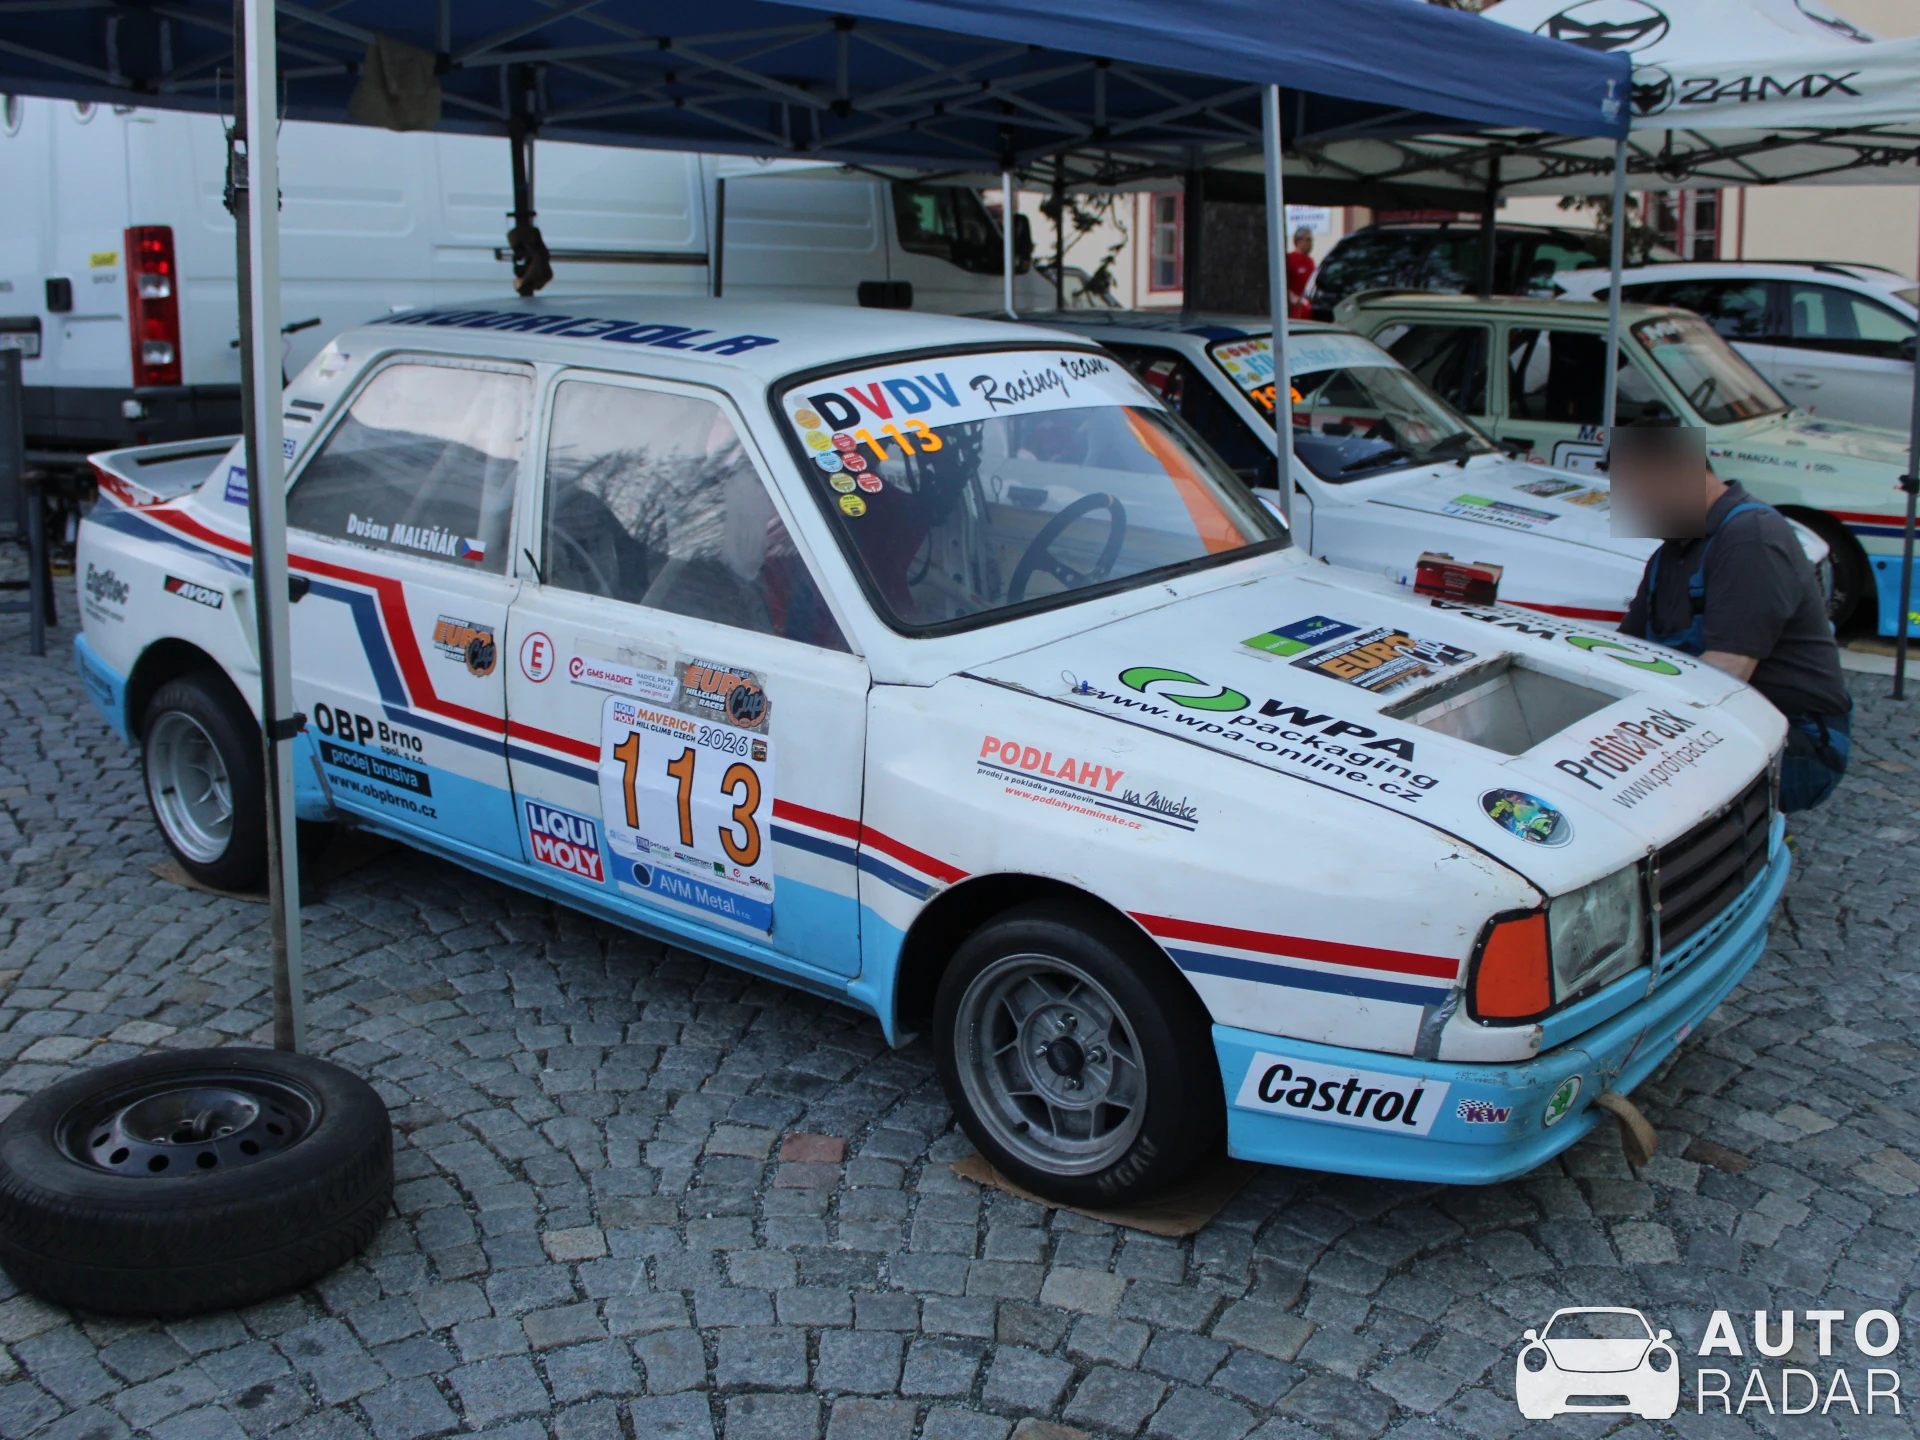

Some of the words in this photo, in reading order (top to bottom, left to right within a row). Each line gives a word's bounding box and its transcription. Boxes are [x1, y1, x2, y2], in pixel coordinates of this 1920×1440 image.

[1679, 72, 1862, 104] 24MX
[808, 372, 961, 432] DVDV
[969, 364, 1068, 412] Racing
[1060, 356, 1110, 381] team
[854, 418, 944, 461] 113
[346, 513, 389, 541] Dušan
[390, 523, 460, 557] MALEŇÁK
[175, 582, 223, 608] AVON
[531, 641, 544, 669] E
[1318, 635, 1417, 680] EURO
[587, 668, 604, 679] GMS
[605, 673, 633, 686] HADICE
[638, 680, 671, 692] HYDRAULIKA
[686, 687, 726, 703] HILLCLIMB
[614, 702, 636, 715] LIQUI
[614, 711, 635, 725] MOLY
[637, 708, 697, 733] MAVERICK
[699, 699, 725, 711] RACES
[314, 702, 374, 747] OBP
[378, 721, 423, 752] Brno
[636, 720, 650, 731] HILL
[651, 725, 672, 736] CLIMB
[674, 730, 696, 742] CZECH
[698, 726, 748, 756] 2026
[1088, 685, 1424, 803] www.wpa-online.cz
[1258, 698, 1415, 763] WPA
[331, 748, 371, 776] prodej
[372, 758, 419, 788] brusiva
[979, 735, 1125, 793] PODLAHY
[1122, 788, 1141, 806] na
[1228, 714, 1440, 791] packaging
[1612, 730, 1725, 810] www.profipack.cz
[328, 773, 438, 819] www.obpbrno.cz
[613, 730, 762, 868] 113
[977, 767, 1003, 781] prodej
[1011, 776, 1047, 792] pokládka
[1049, 786, 1095, 805] podlahovin
[528, 804, 595, 850] LIQUI
[1004, 786, 1142, 830] www.podlahynaminske.cz
[536, 836, 600, 879] MOLY
[660, 874, 692, 899] AVM
[695, 887, 735, 915] Metal
[1257, 1063, 1425, 1126] Castrol
[1466, 1104, 1512, 1124] KW
